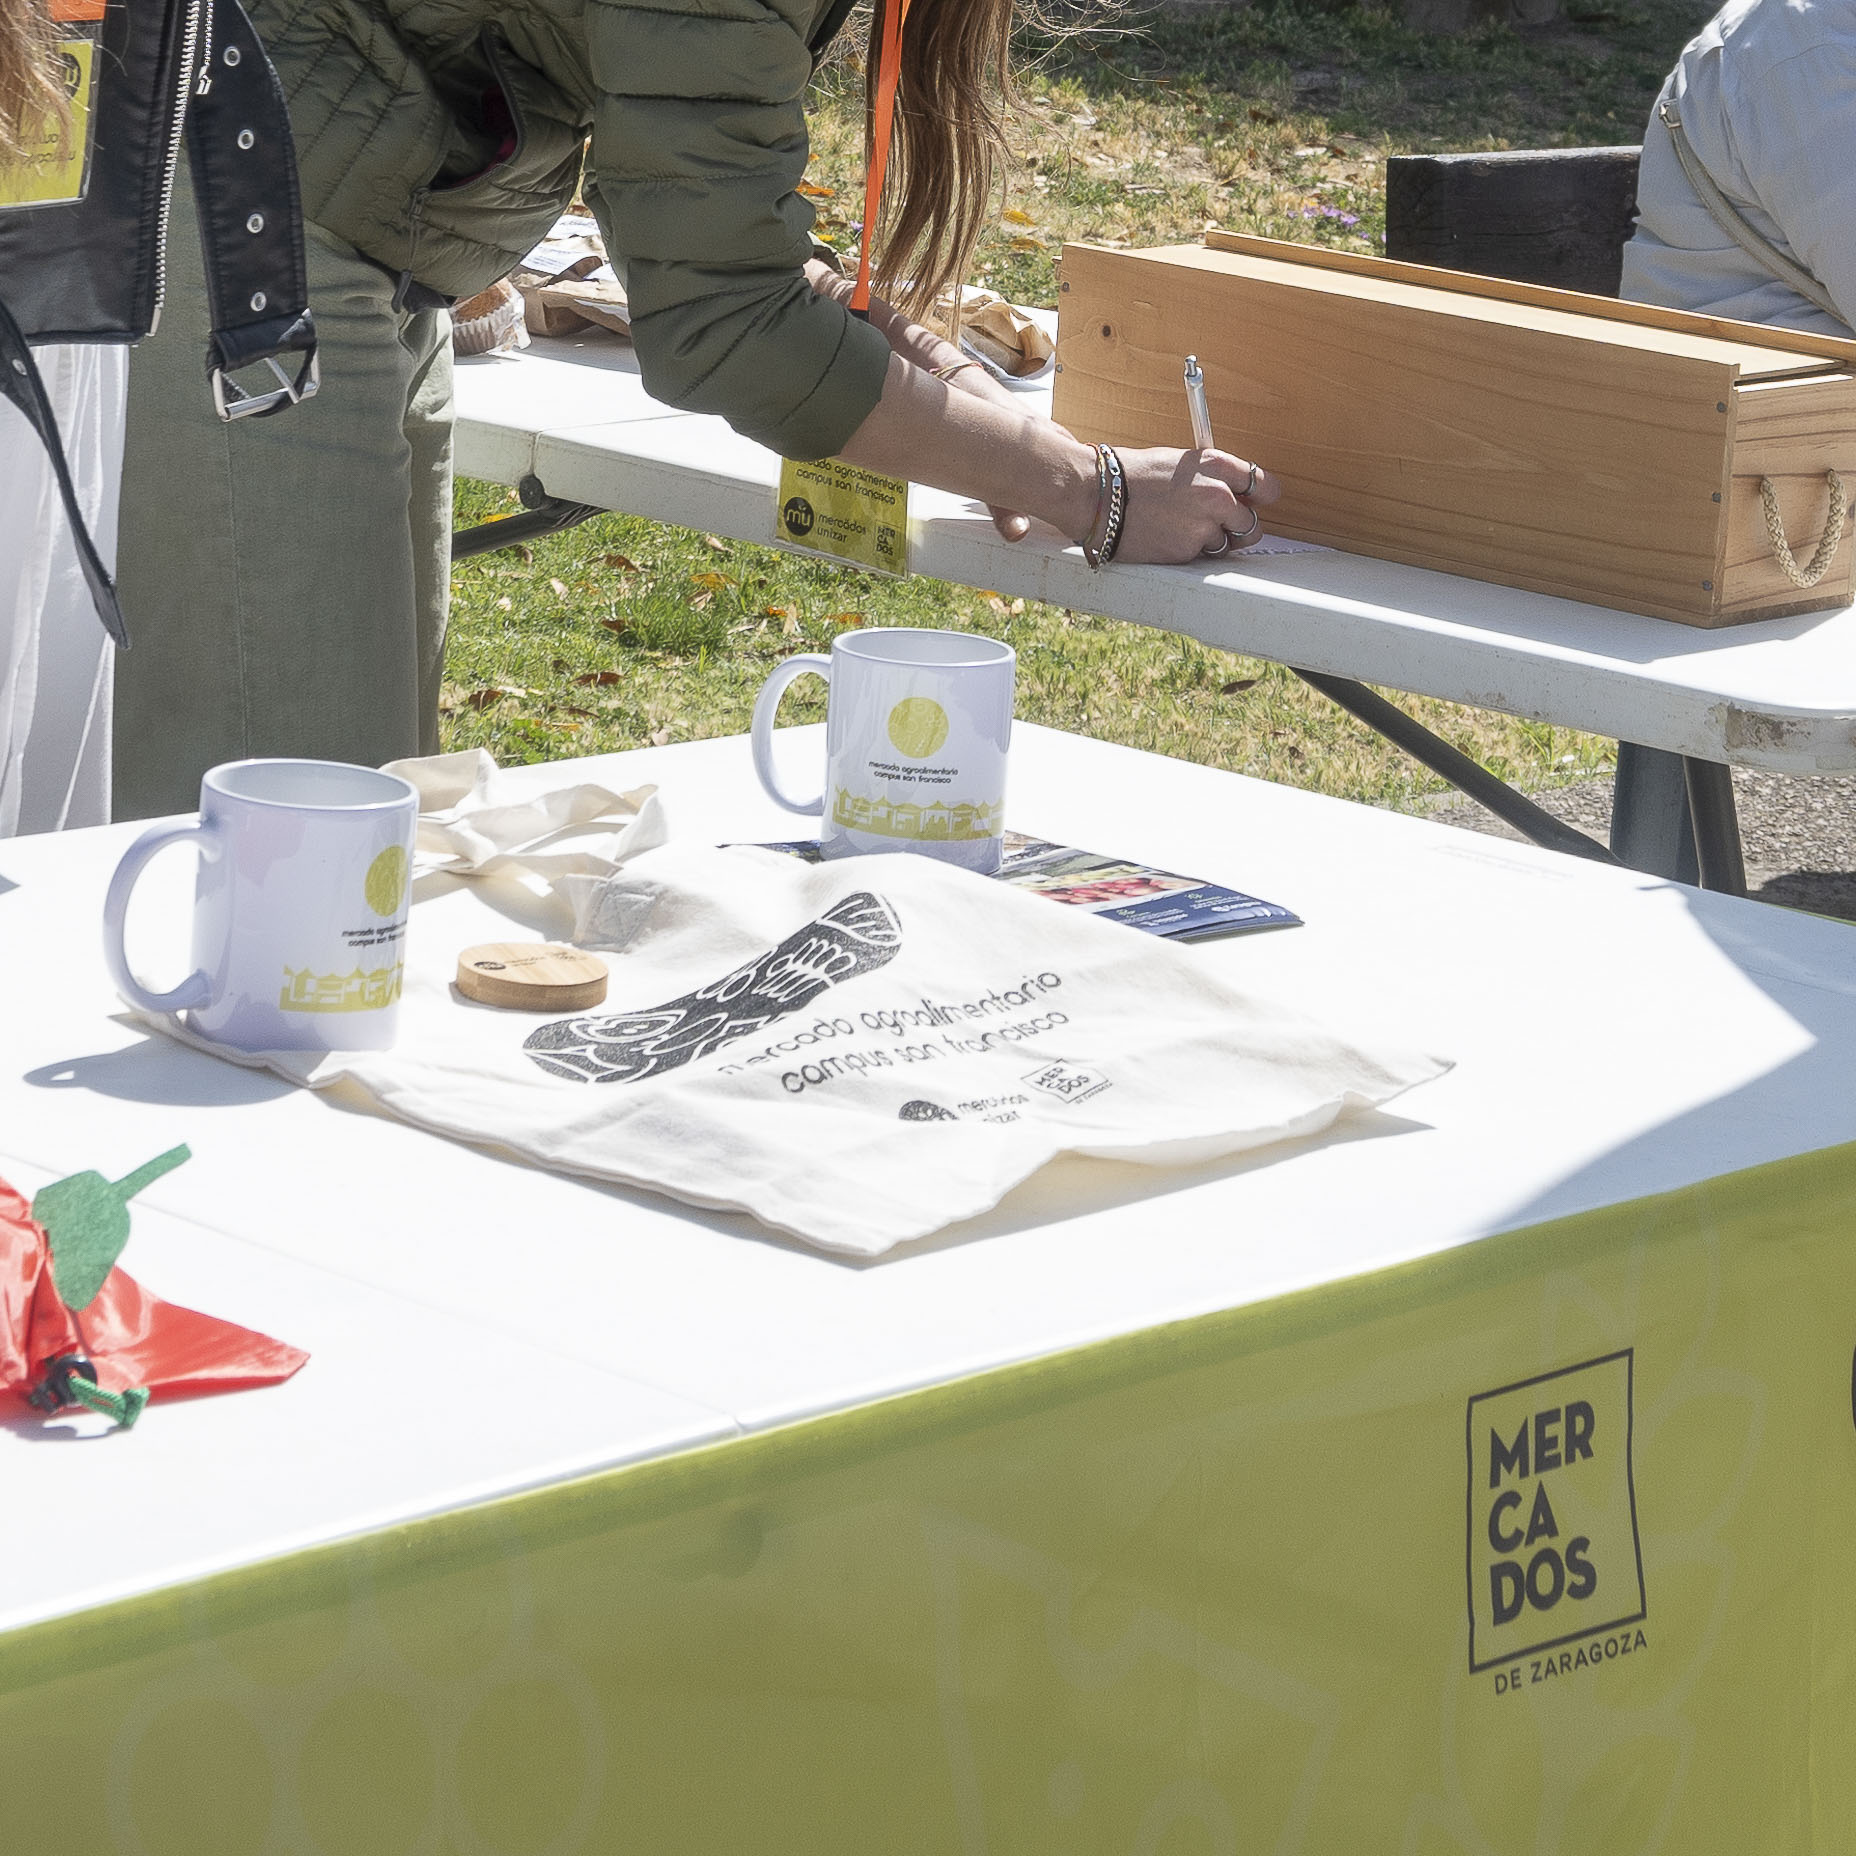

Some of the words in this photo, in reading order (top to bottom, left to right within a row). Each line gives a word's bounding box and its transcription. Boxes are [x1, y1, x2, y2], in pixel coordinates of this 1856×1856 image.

[796, 468, 832, 486] campus
[835, 480, 852, 492] san
[855, 484, 896, 505] francisco
[834, 465, 904, 494] agroalimentario
[817, 527, 847, 543] unizar
[860, 970, 1063, 1037] agroalimentario
[781, 1048, 890, 1094] campus
[894, 1041, 941, 1063] san
[943, 1010, 1070, 1056] francisco
[1489, 1400, 1595, 1490] MER
[1488, 1480, 1559, 1554] CA
[1489, 1536, 1597, 1627] DOS
[1494, 1667, 1522, 1695] DE
[1531, 1629, 1648, 1684] ZARAGOZA
